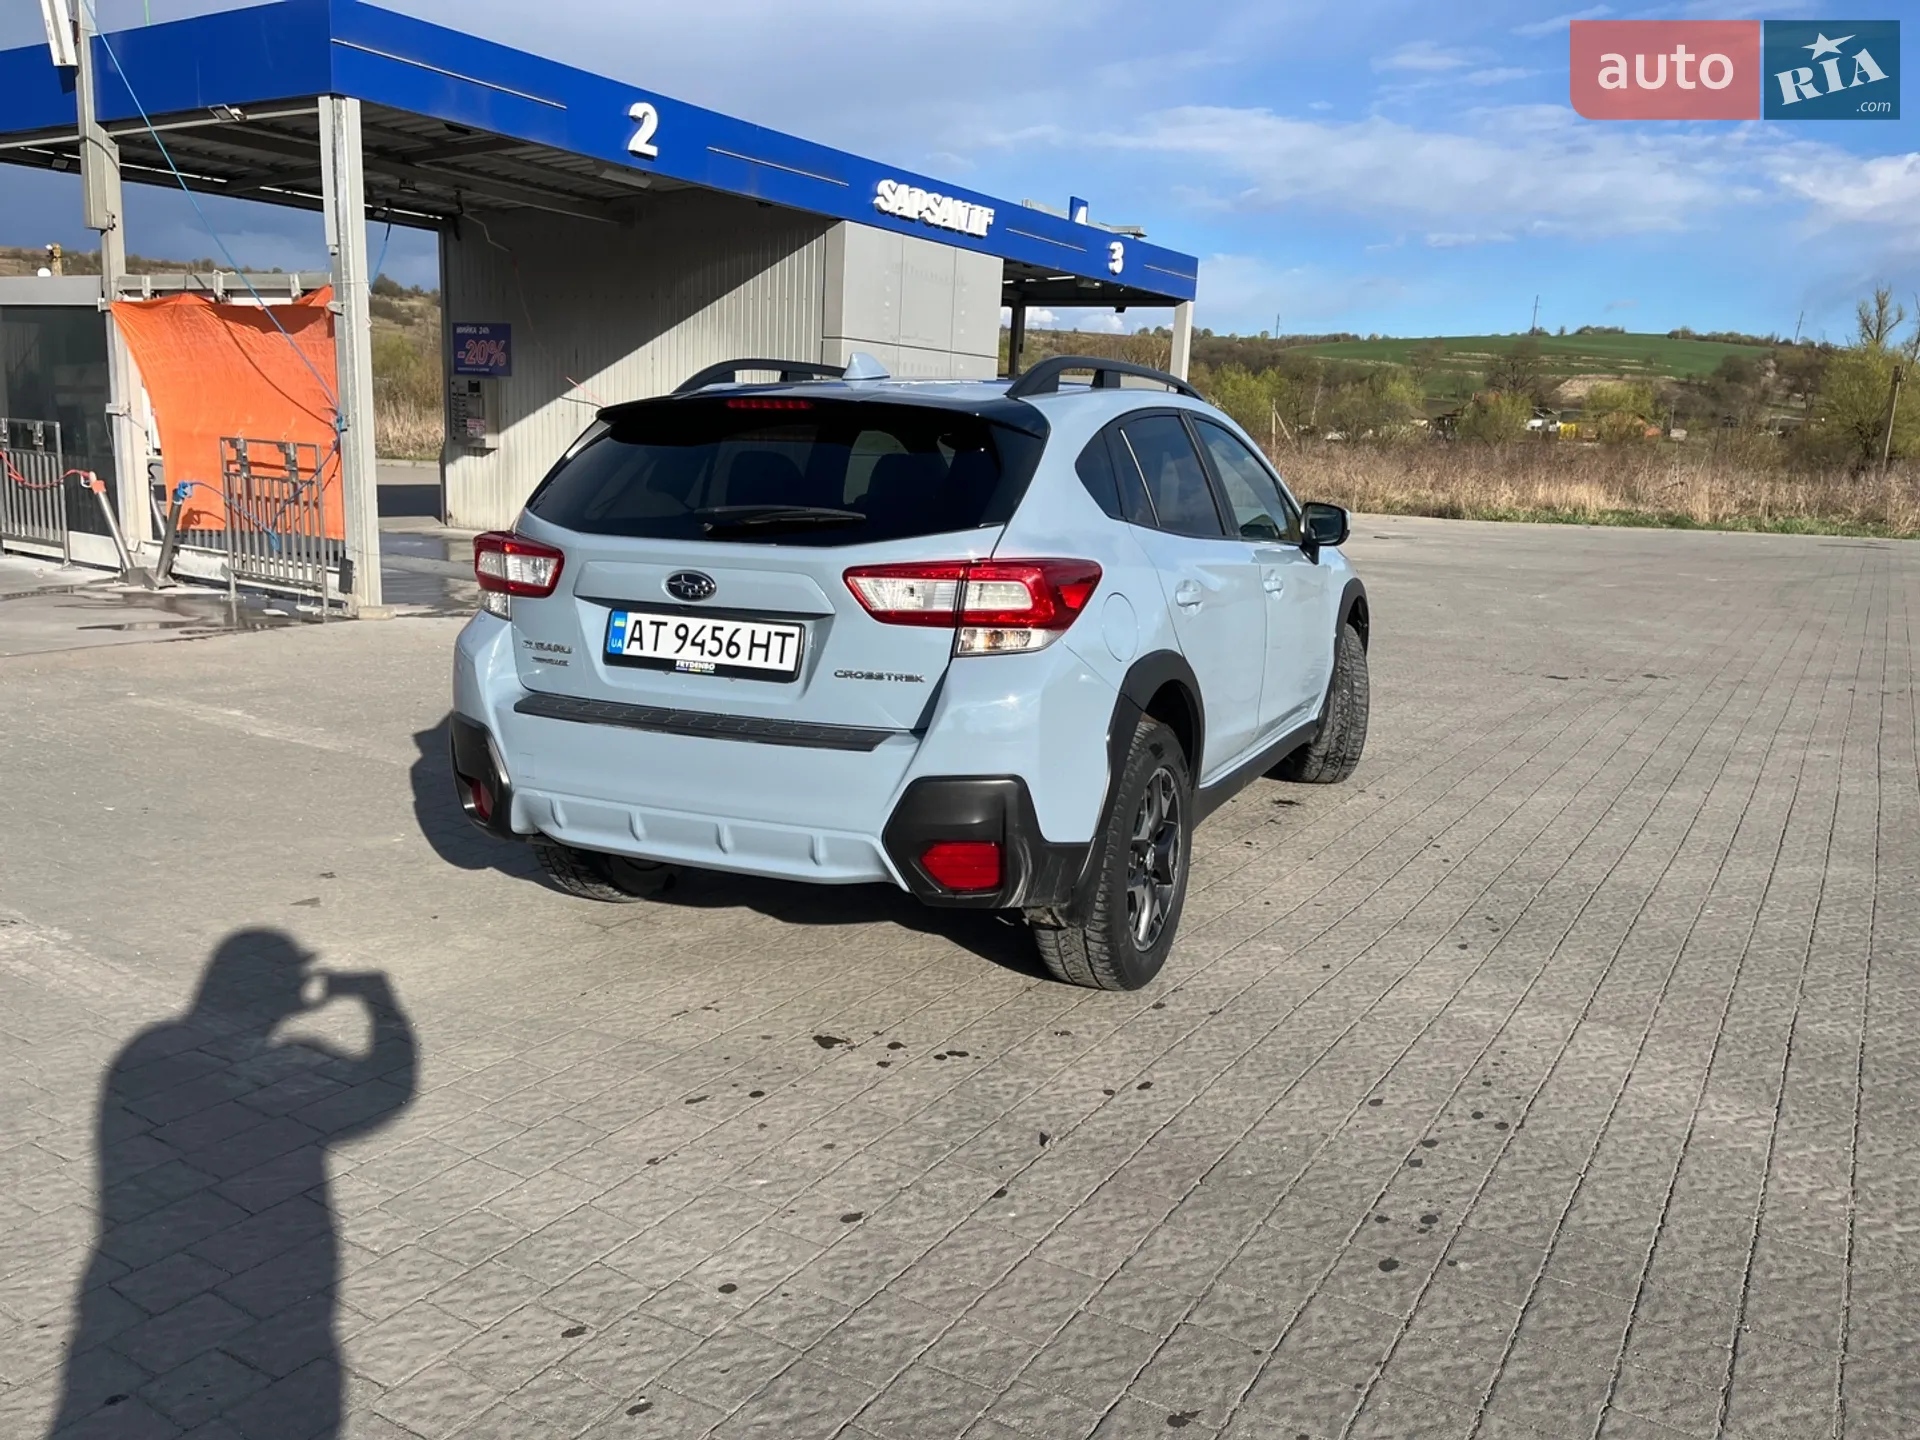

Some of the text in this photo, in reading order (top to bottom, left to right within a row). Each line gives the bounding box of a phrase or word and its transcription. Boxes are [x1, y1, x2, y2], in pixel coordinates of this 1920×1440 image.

[627, 101, 659, 158] 2
[1108, 241, 1124, 274] 3
[457, 339, 507, 367] -20%
[610, 638, 623, 649] UA
[626, 620, 795, 664] AT 9456 HT
[833, 669, 925, 684] CROSSTREK
